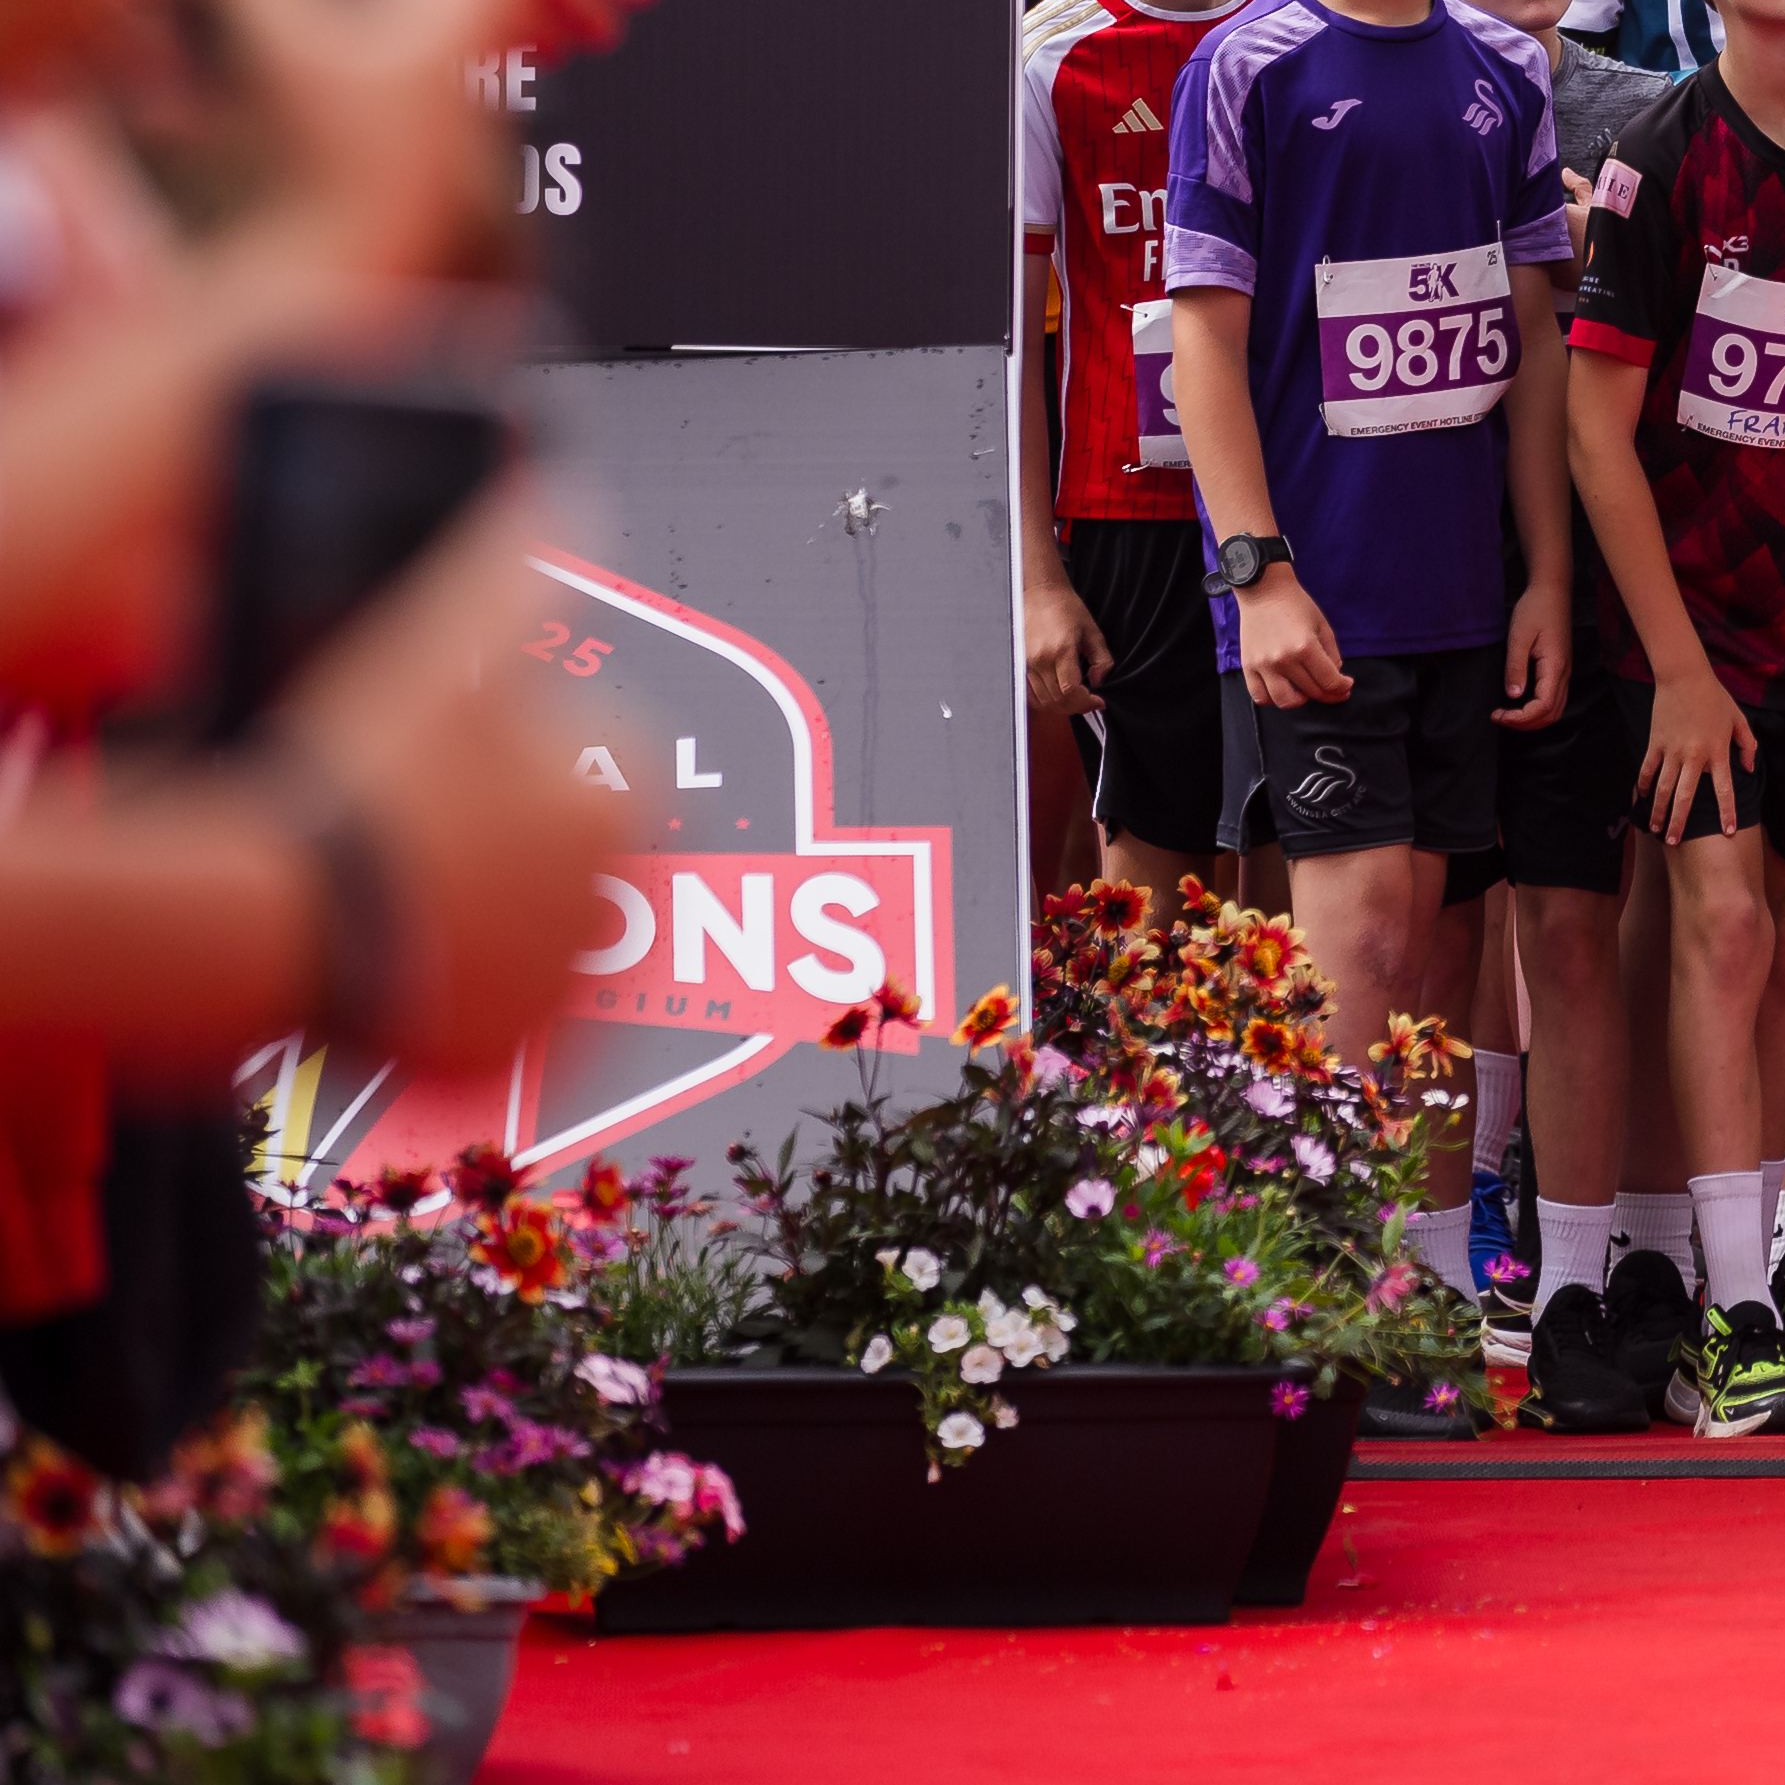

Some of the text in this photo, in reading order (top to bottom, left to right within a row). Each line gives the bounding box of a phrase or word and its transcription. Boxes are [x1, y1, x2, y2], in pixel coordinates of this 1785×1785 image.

[1408, 262, 1460, 303] 5K
[1345, 307, 1508, 391] 9875
[1350, 422, 1409, 435] EMERGENCY
[1410, 419, 1438, 430] EVENT
